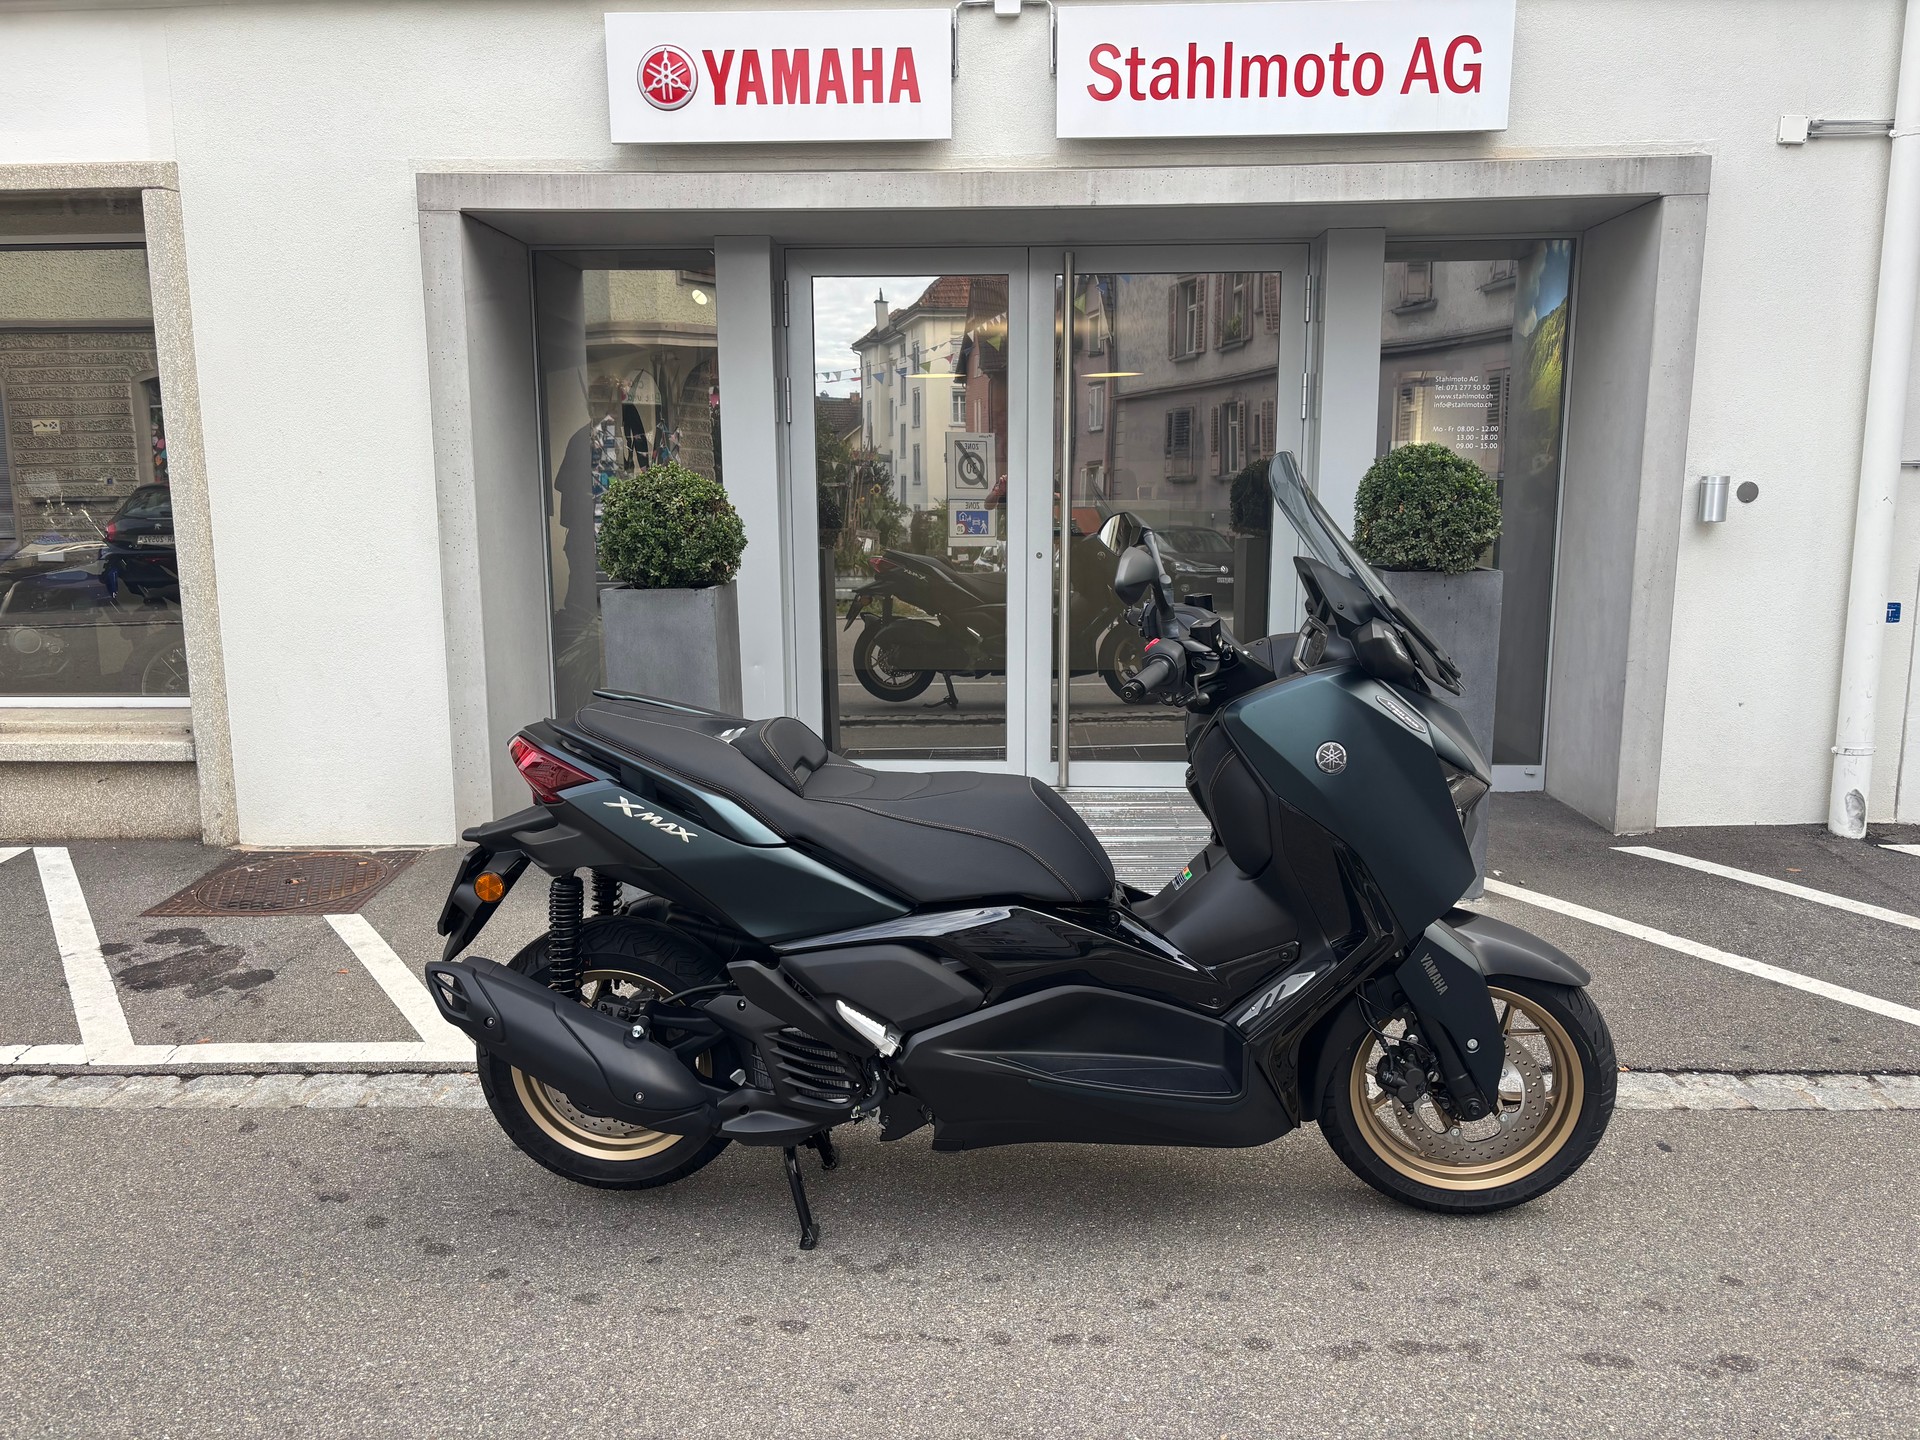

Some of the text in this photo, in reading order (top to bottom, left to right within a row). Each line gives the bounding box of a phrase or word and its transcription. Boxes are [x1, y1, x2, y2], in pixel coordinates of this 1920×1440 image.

[701, 47, 921, 105] YAMAHA
[1087, 35, 1482, 101] Stahlmoto AG
[1435, 375, 1468, 383] Stahlmoto
[1420, 952, 1449, 996] YAMAHA
